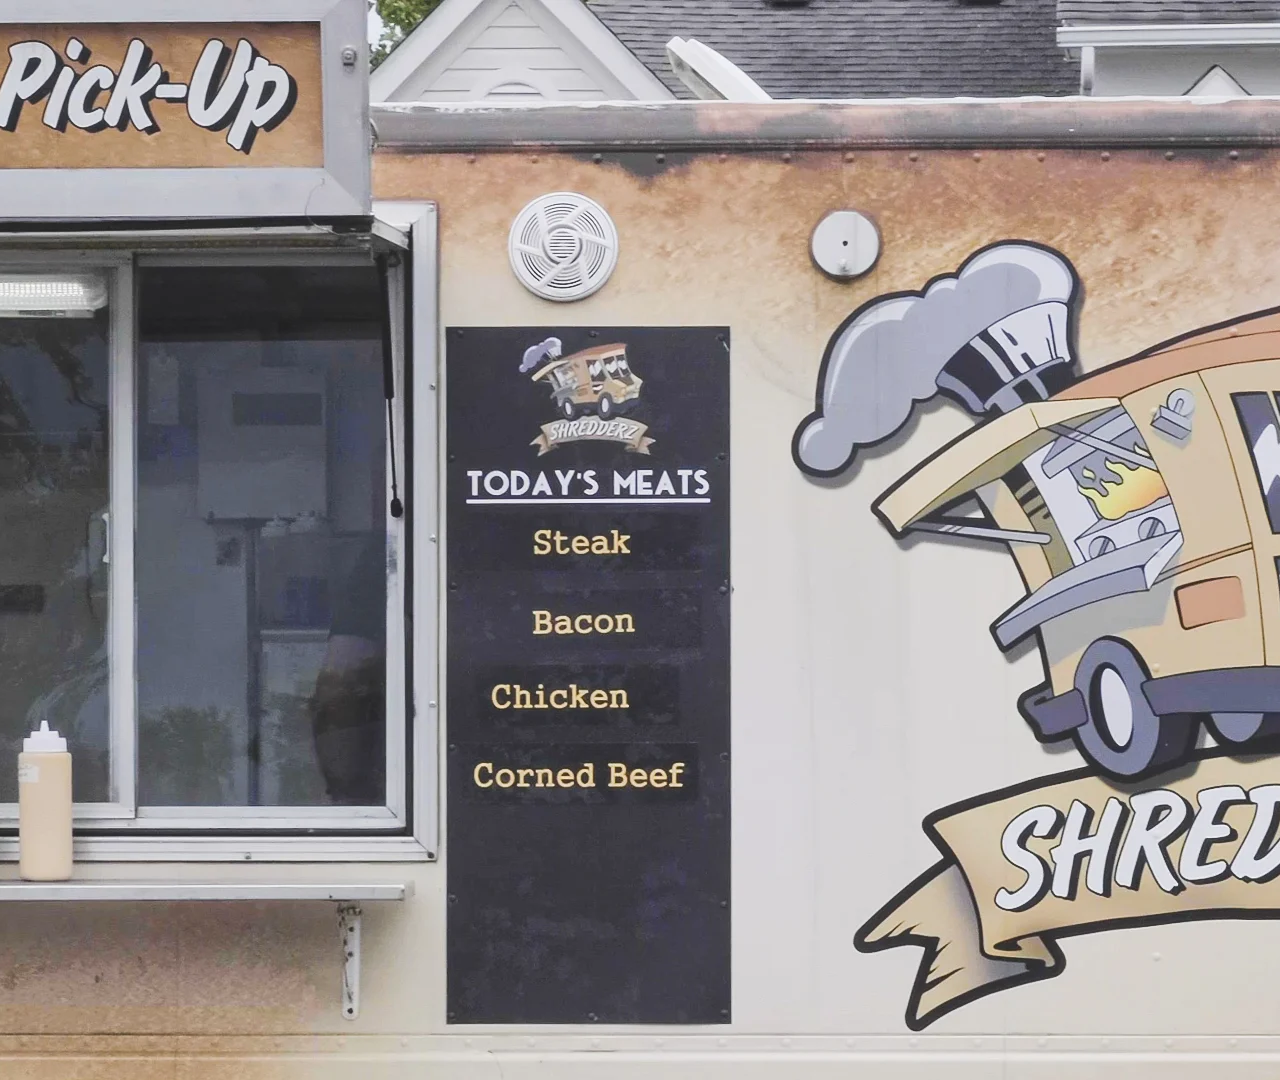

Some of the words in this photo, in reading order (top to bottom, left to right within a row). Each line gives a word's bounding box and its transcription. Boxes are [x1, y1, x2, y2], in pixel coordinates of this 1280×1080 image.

[549, 420, 640, 441] SHREDDERZ
[466, 469, 599, 496] TODAY'S
[613, 468, 710, 496] MEATS
[533, 529, 631, 556] Steak
[532, 611, 636, 636] Bacon
[491, 684, 630, 710] Chicken
[473, 762, 596, 789] Corned
[608, 762, 686, 789] Beef
